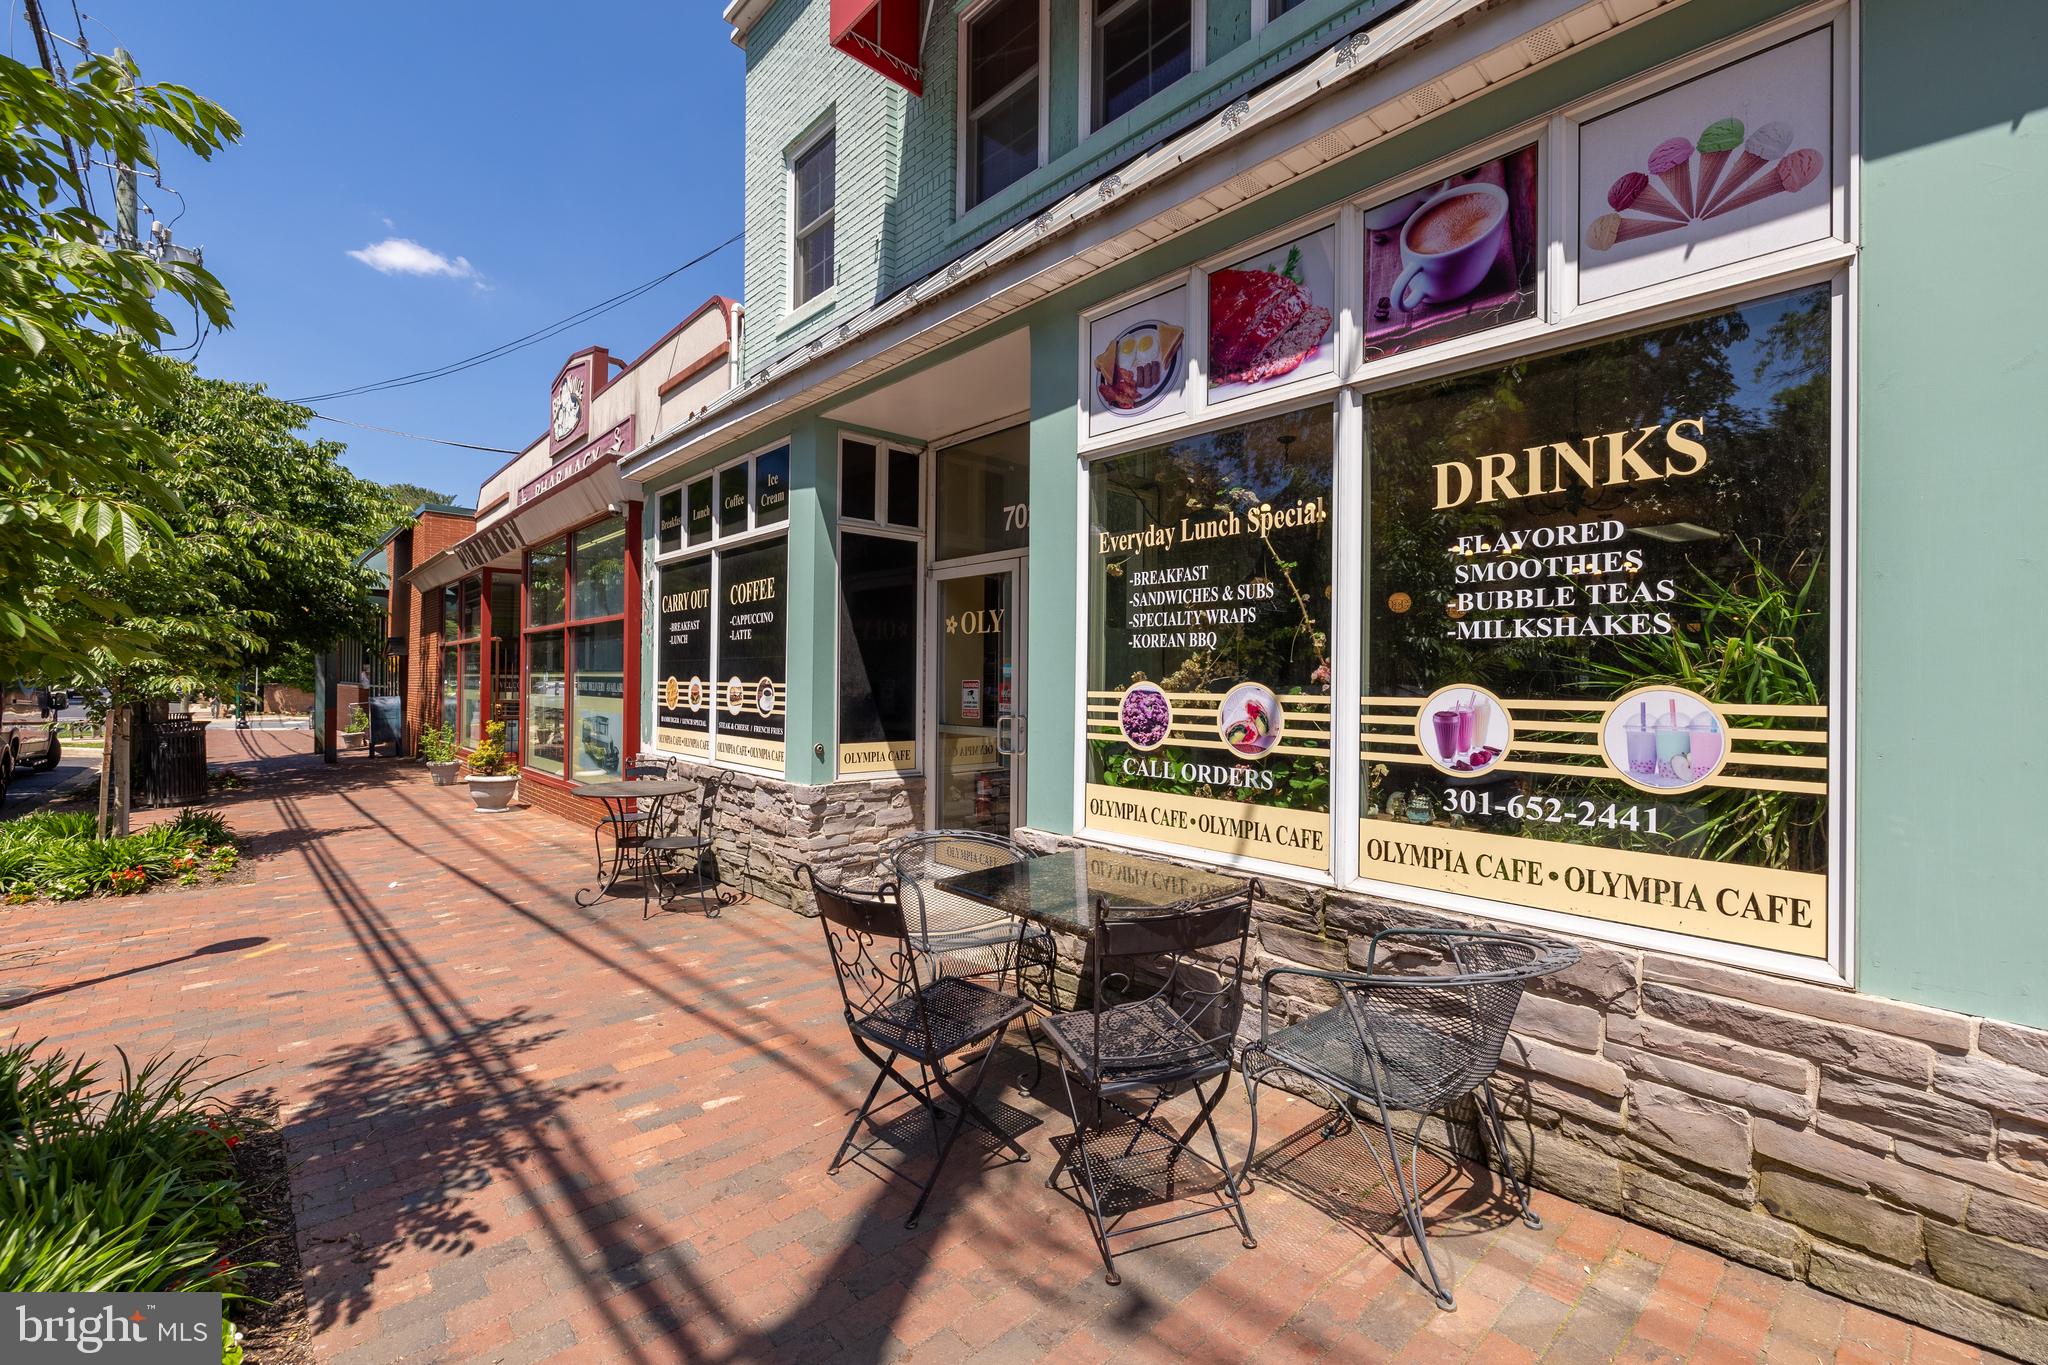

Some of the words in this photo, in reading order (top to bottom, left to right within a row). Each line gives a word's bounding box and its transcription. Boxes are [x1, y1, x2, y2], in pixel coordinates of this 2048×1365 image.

[1431, 417, 1708, 510] DRINKS
[768, 474, 779, 487] Ice
[724, 494, 744, 510] Coffee
[761, 491, 785, 507] Cream
[693, 505, 710, 521] Lunch
[1004, 504, 1030, 531] 70
[1098, 525, 1176, 555] Everyday
[1180, 511, 1240, 542] Lunch
[1248, 497, 1324, 538] Special
[1448, 520, 1624, 556] -FLAVORED
[1129, 565, 1208, 586] -BREAKFAST
[1455, 548, 1643, 584] SMOOTHIES
[662, 592, 689, 613] CARRY
[691, 588, 709, 609] OUT
[730, 577, 775, 605] COFFEE
[1129, 587, 1218, 607] -SANDWICHES
[1222, 586, 1234, 601] &
[1238, 582, 1274, 600] SUBS
[1446, 587, 1575, 612] -BUBBLE
[1588, 579, 1675, 605] TEAS
[669, 620, 700, 632] -BREAKFAST
[730, 612, 774, 626] -CAPPUCCINO
[960, 609, 1005, 635] OLY
[1129, 610, 1204, 628] -SPECIALTY
[1206, 608, 1256, 624] WRAPS
[1447, 613, 1672, 640] -MILKSHAKES
[669, 635, 688, 644] -LUNCH
[730, 629, 752, 640] -LATTE
[1129, 633, 1186, 648] -KOREAN
[1190, 632, 1217, 650] BBQ
[754, 725, 770, 734] FRENCH
[771, 727, 783, 735] FRIES
[717, 742, 735, 754] OLYMPIA
[736, 745, 747, 756] CAFE
[750, 747, 770, 760] OLYMPIA
[771, 750, 784, 762] CAFE
[844, 751, 886, 764] OLYMPIA
[888, 749, 911, 762] CAFE
[1123, 758, 1175, 780] CALL
[1181, 763, 1273, 790] ORDERS
[1090, 798, 1147, 823] OLYMPIA
[1151, 808, 1188, 829] CAFE
[1199, 814, 1272, 843] OLYMPIA
[1276, 825, 1324, 851] CAFE
[1442, 789, 1660, 835] 301-652-2441
[1367, 839, 1469, 875] OLYMPIA
[1476, 854, 1543, 887] CAFE
[1565, 867, 1706, 912] OLYMPIA
[1716, 889, 1813, 929] CAFE
